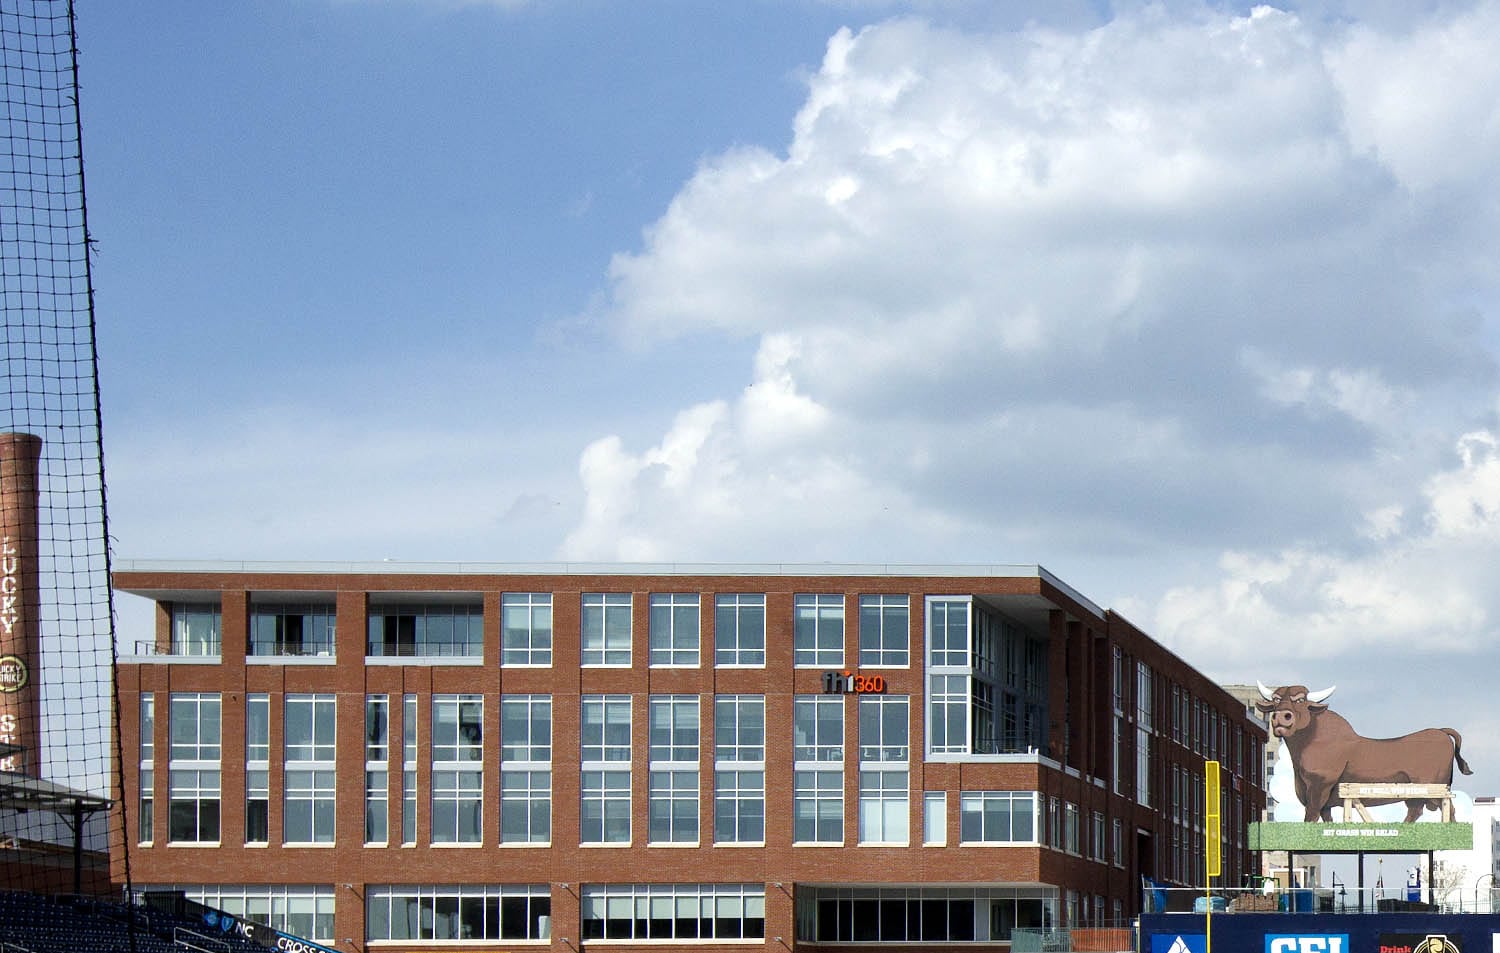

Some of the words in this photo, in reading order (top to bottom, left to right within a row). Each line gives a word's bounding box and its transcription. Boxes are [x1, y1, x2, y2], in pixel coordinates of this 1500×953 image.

[1, 537, 18, 633] LUCKY
[855, 675, 884, 692] 360
[235, 921, 254, 938] NC
[1380, 946, 1411, 953] Drink
